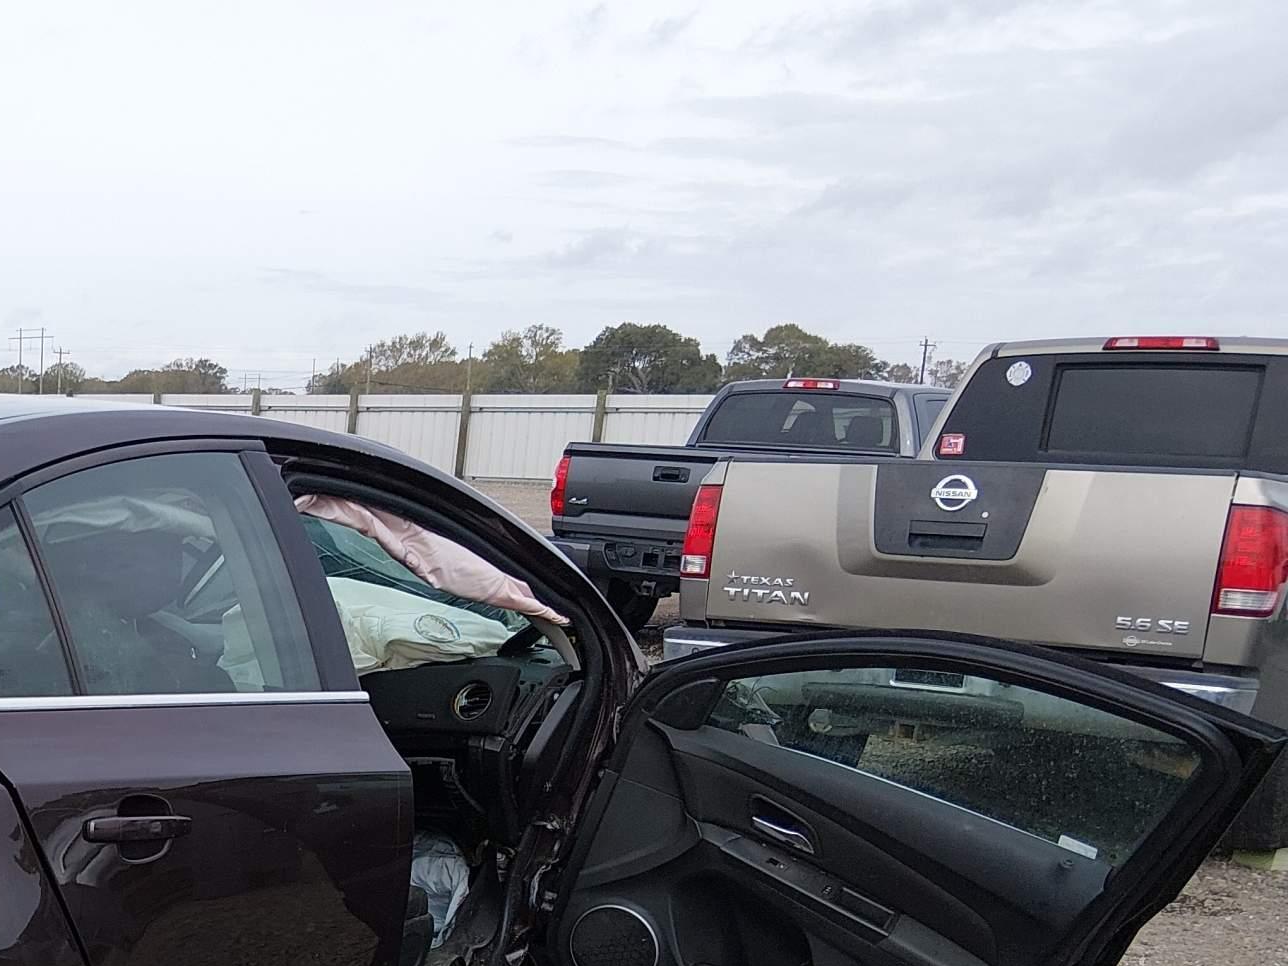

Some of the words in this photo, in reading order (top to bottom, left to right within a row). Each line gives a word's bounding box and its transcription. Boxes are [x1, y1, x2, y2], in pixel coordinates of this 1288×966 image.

[934, 490, 972, 498] NISSAN
[740, 575, 794, 587] TEXAS
[723, 587, 810, 606] TITAN
[1115, 616, 1152, 632] 5.6
[1156, 620, 1190, 636] SE
